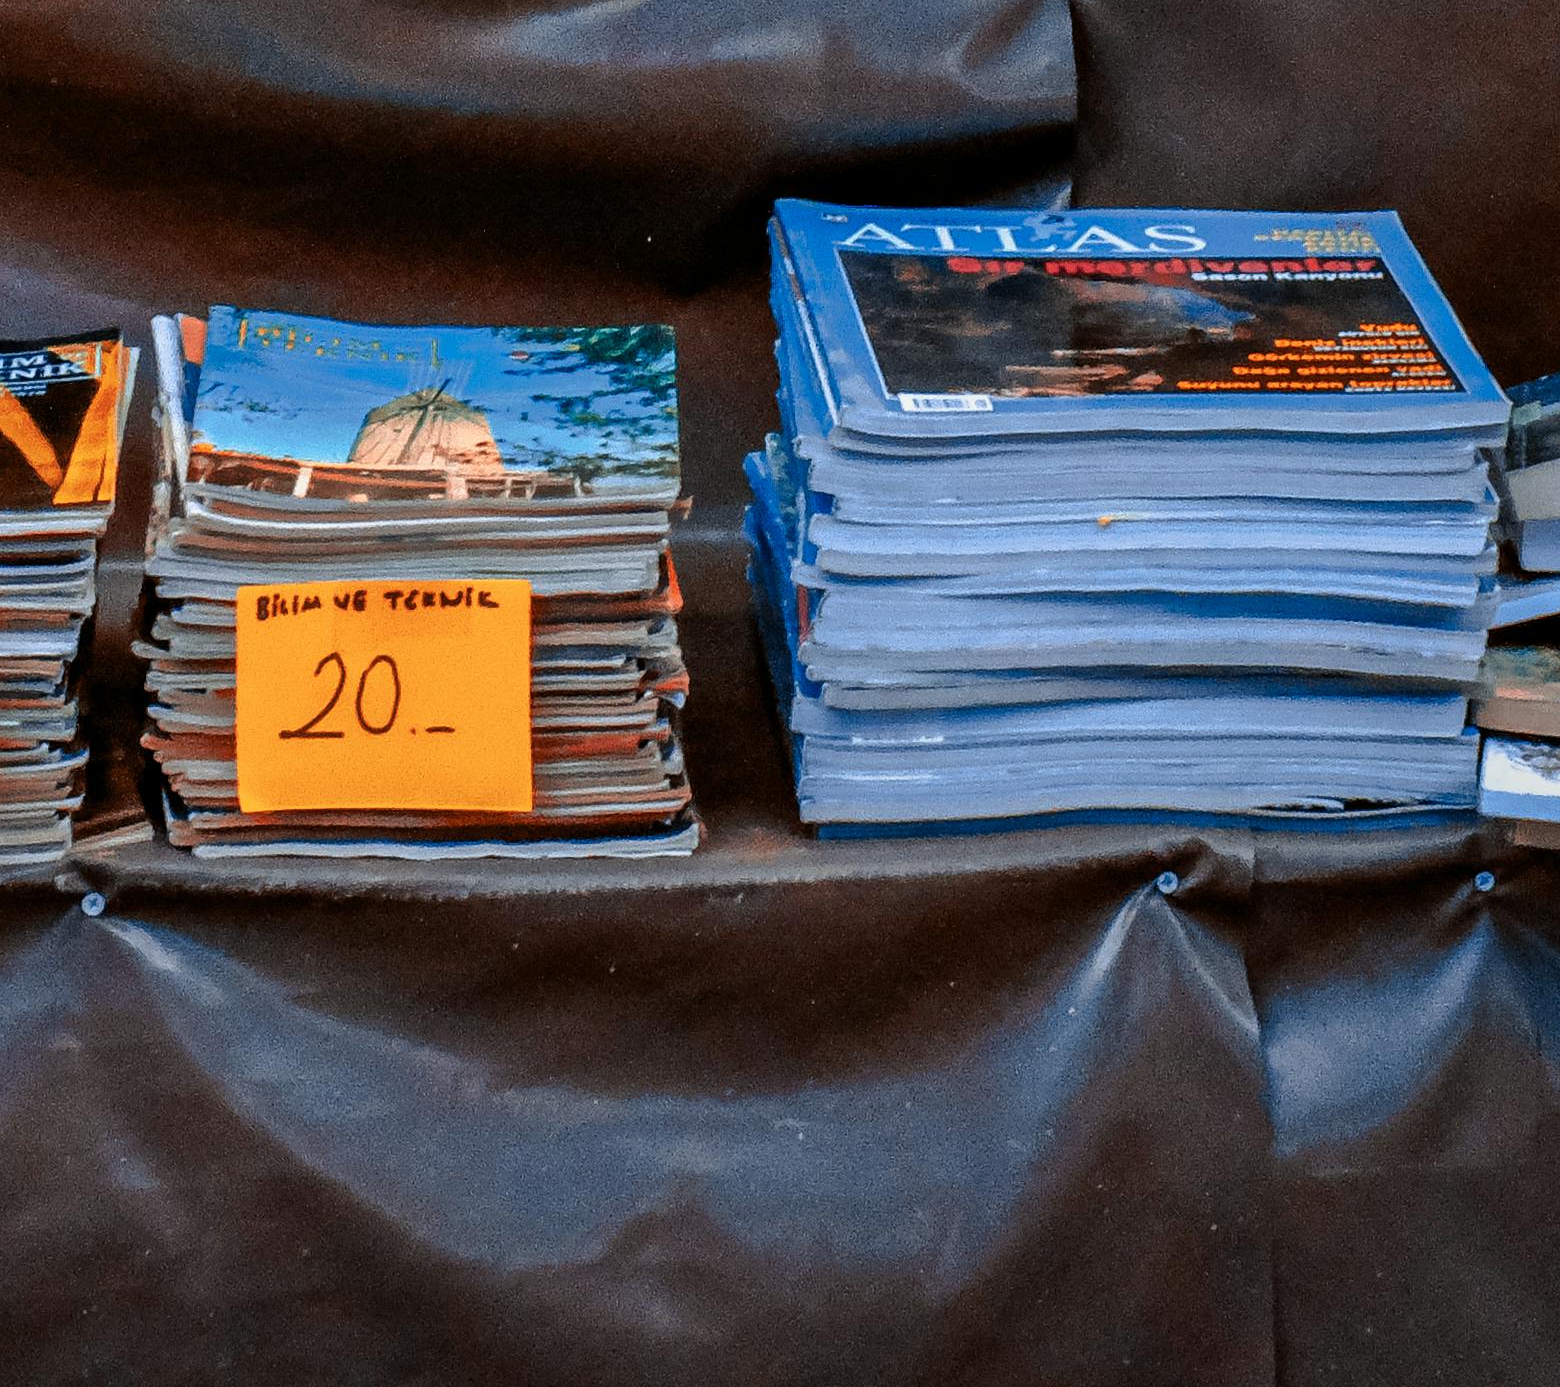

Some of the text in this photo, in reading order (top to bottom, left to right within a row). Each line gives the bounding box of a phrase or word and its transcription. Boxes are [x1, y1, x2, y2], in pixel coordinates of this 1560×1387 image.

[832, 223, 1207, 253] ATLAS
[256, 587, 501, 623] BİLİM VE TEKNİK
